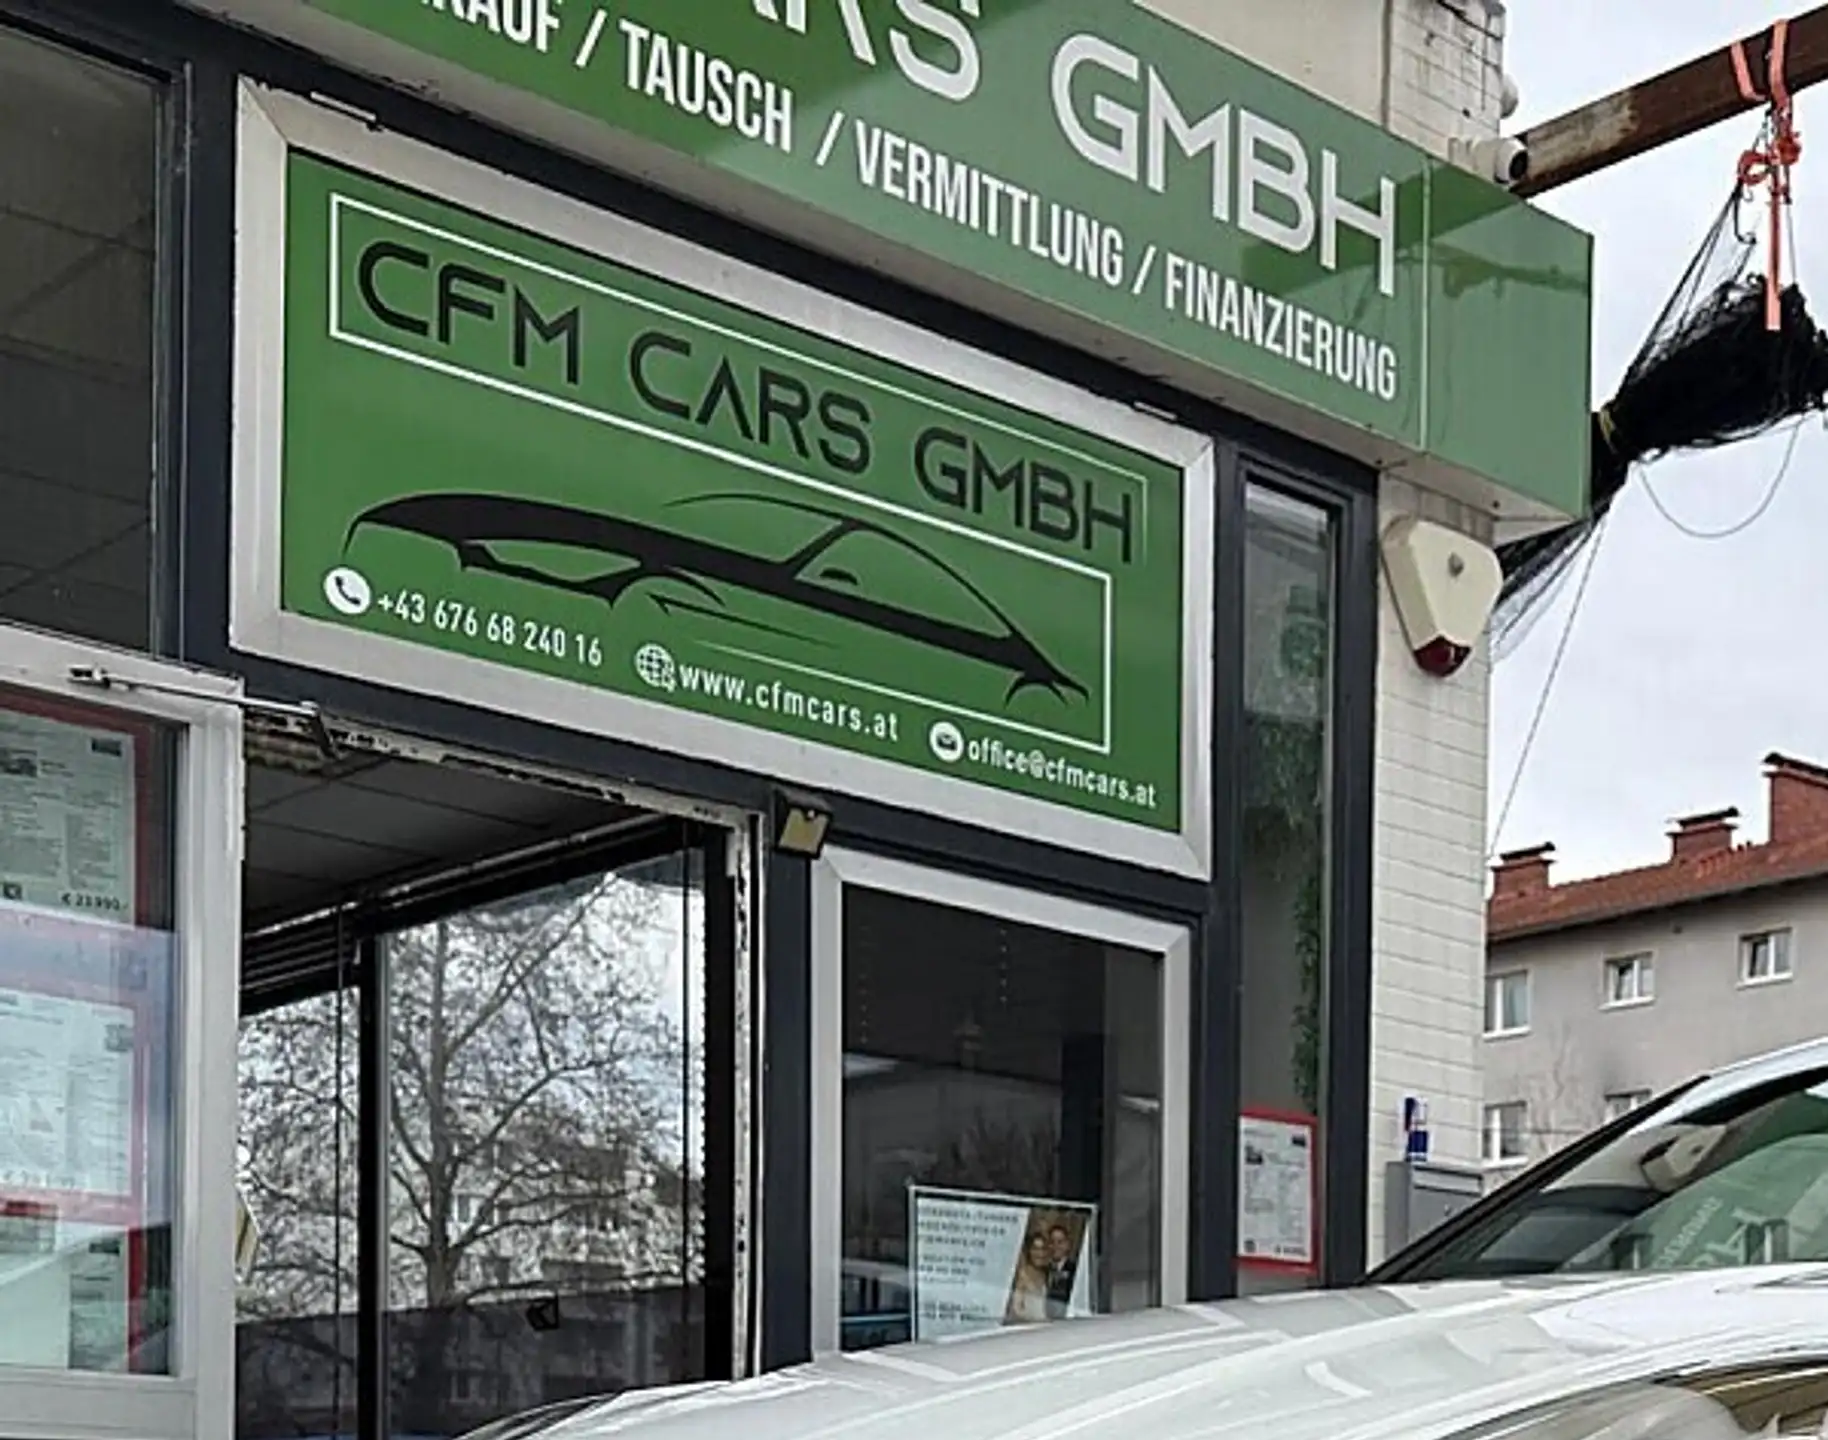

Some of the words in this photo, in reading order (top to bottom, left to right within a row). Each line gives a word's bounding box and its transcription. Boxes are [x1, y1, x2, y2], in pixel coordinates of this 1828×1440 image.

[619, 18, 793, 153] TAUSCH
[856, 118, 1124, 286] VERMITTLUNG
[1166, 252, 1396, 399] FINANZIERUNG
[1051, 33, 1395, 296] GMBH
[358, 241, 579, 385] CFM
[630, 331, 870, 474] CARS
[915, 427, 1131, 564] GMBH
[378, 590, 425, 623] +43
[434, 600, 477, 636] 676
[487, 613, 515, 645] 68
[524, 622, 566, 657] 240
[576, 633, 602, 666] 16
[679, 661, 897, 741] www.cfmcars.at
[968, 737, 1156, 809] office@cfmcars.at
